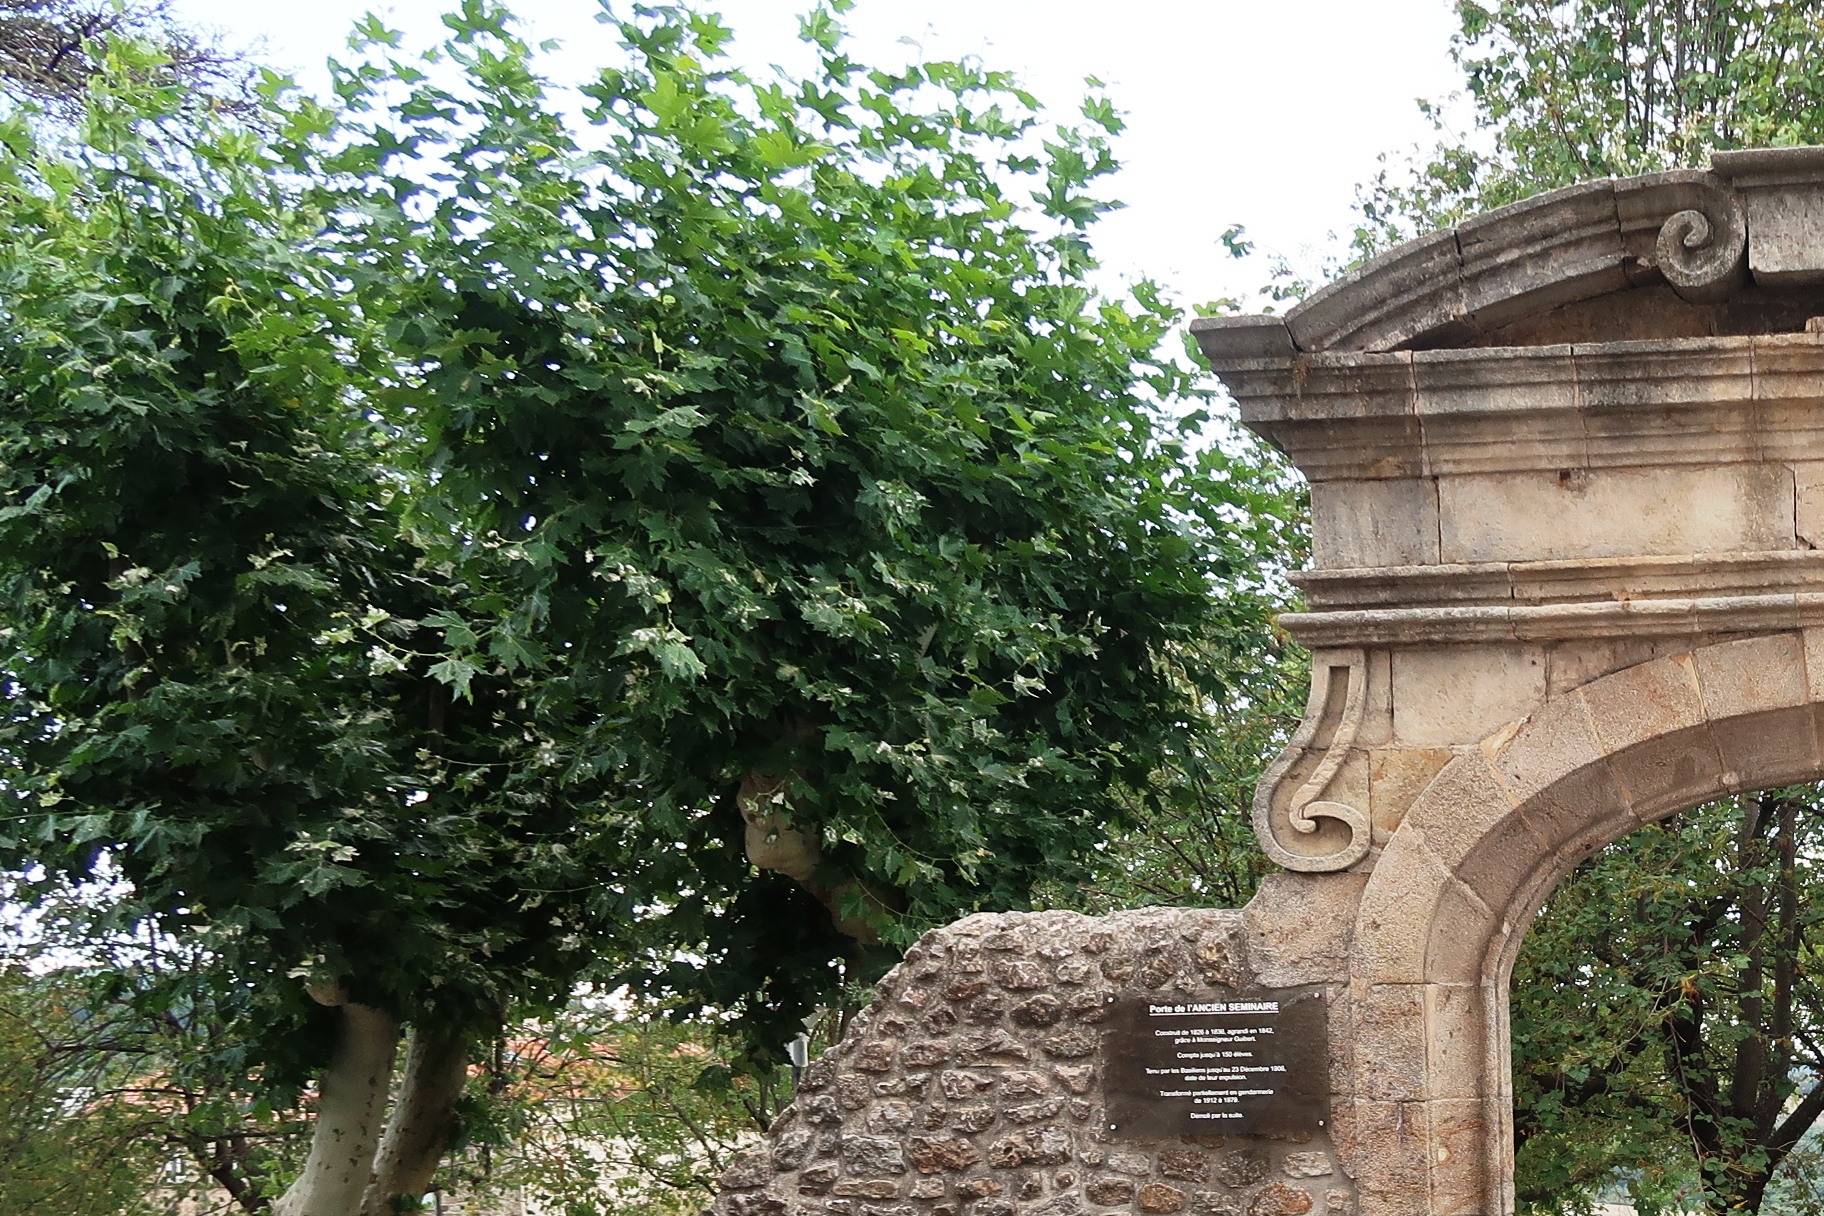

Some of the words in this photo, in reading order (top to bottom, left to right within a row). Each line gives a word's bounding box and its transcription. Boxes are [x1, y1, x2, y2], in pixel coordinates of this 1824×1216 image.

[1150, 1005, 1173, 1013] Porte
[1175, 1005, 1185, 1013] de
[1188, 1003, 1227, 1012] l'ANCIEN
[1228, 1002, 1279, 1012] SEMINAIRE
